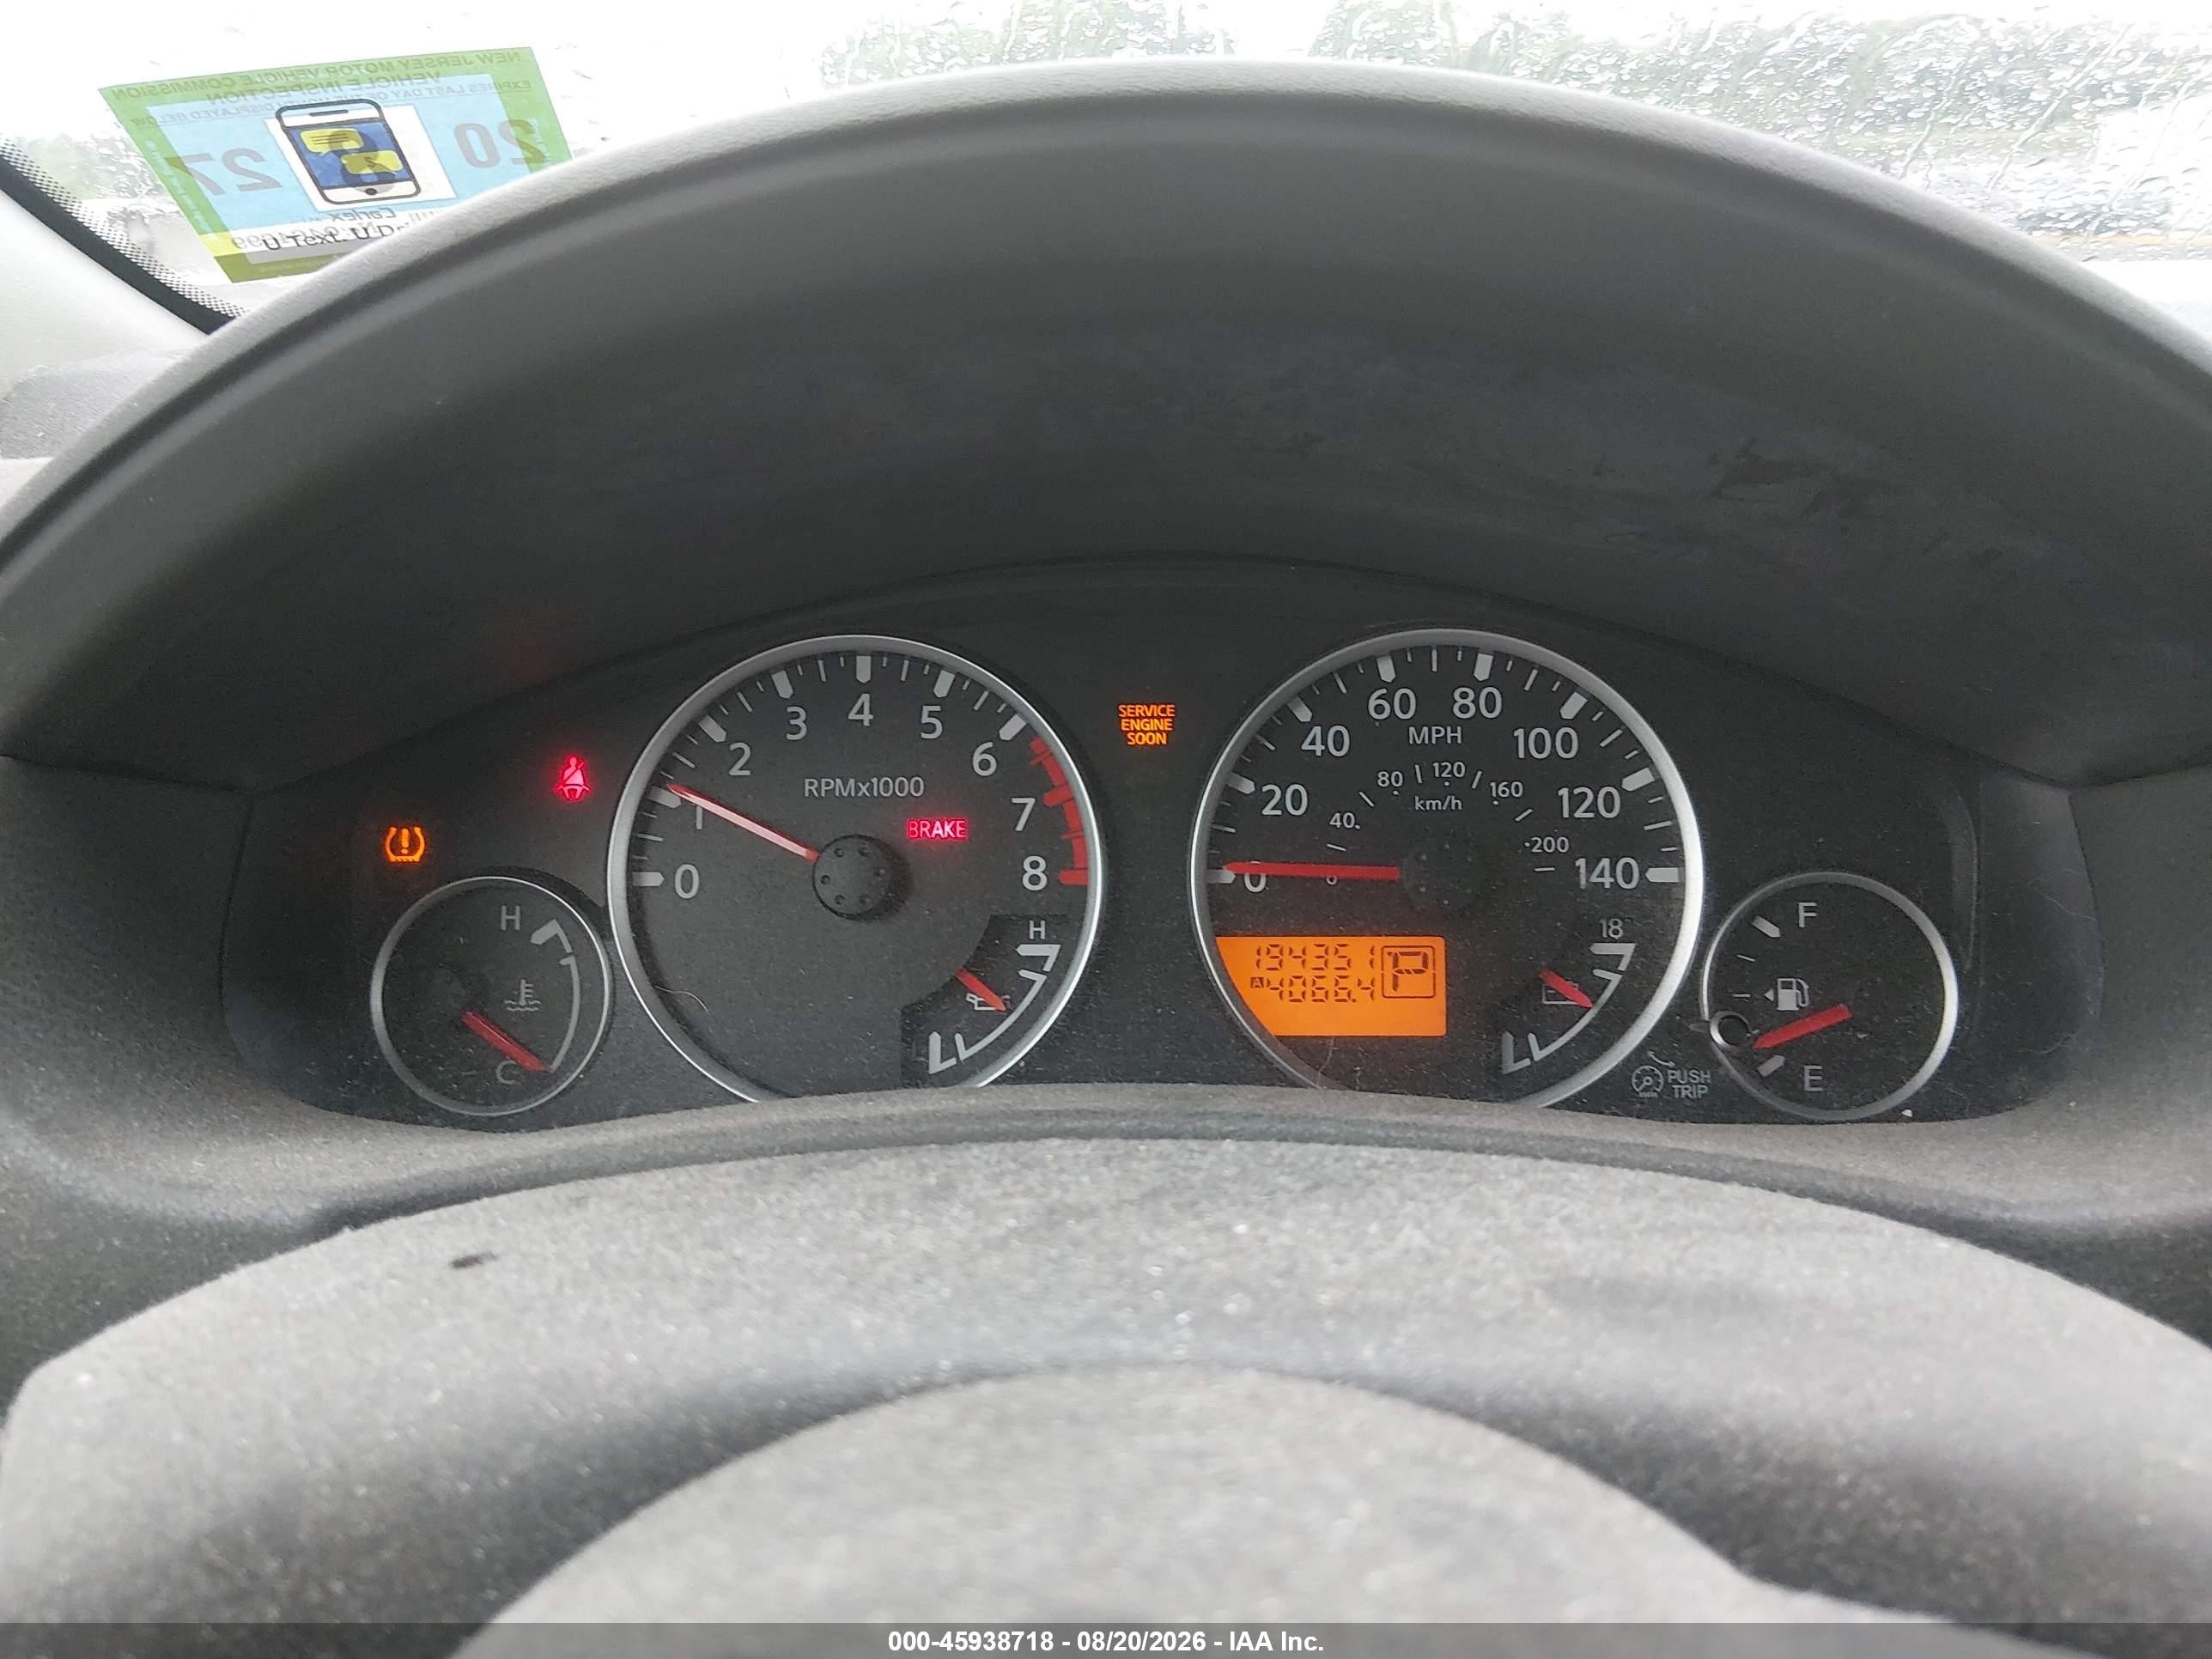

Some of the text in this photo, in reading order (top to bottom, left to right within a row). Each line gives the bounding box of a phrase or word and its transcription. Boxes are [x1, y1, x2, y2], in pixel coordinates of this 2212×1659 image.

[848, 694, 873, 727] 4
[1118, 703, 1176, 718] SERVICE
[1368, 689, 1417, 720] 60
[1452, 687, 1502, 719] 80
[787, 708, 807, 739] 3
[921, 706, 943, 739] 5
[1121, 719, 1174, 732] ENGINE
[1409, 726, 1462, 745] MPH
[1127, 732, 1168, 745] SOON
[1301, 725, 1351, 757] 40
[1514, 727, 1578, 759] 100
[730, 744, 752, 775] 2
[973, 742, 997, 776] 6
[1432, 762, 1465, 778] 120
[805, 776, 925, 798] RPMx1000
[1377, 770, 1403, 787] 80
[1490, 781, 1523, 798] 160
[1261, 785, 1308, 816] 20
[1414, 795, 1462, 811] km/h
[1559, 787, 1620, 818] 120
[692, 802, 703, 830] 1
[907, 818, 969, 839] BRAKE
[1012, 799, 1036, 832] 7
[1329, 811, 1355, 829] 40
[1531, 836, 1569, 853] 200
[674, 865, 700, 899] 0
[1023, 856, 1048, 890] 8
[1244, 860, 1267, 893] 0
[1575, 856, 1639, 890] 140
[501, 906, 520, 930] H
[1601, 918, 1624, 939] 18
[1798, 902, 1817, 928] F
[1030, 921, 1046, 939] H
[1255, 943, 1375, 971] 194351
[1386, 951, 1430, 994] P
[1266, 974, 1376, 1003] 4066.4
[496, 1061, 517, 1085] C
[1668, 1068, 1711, 1084] PUSH
[1804, 1065, 1823, 1091] E
[1671, 1085, 1709, 1099] TRIP
